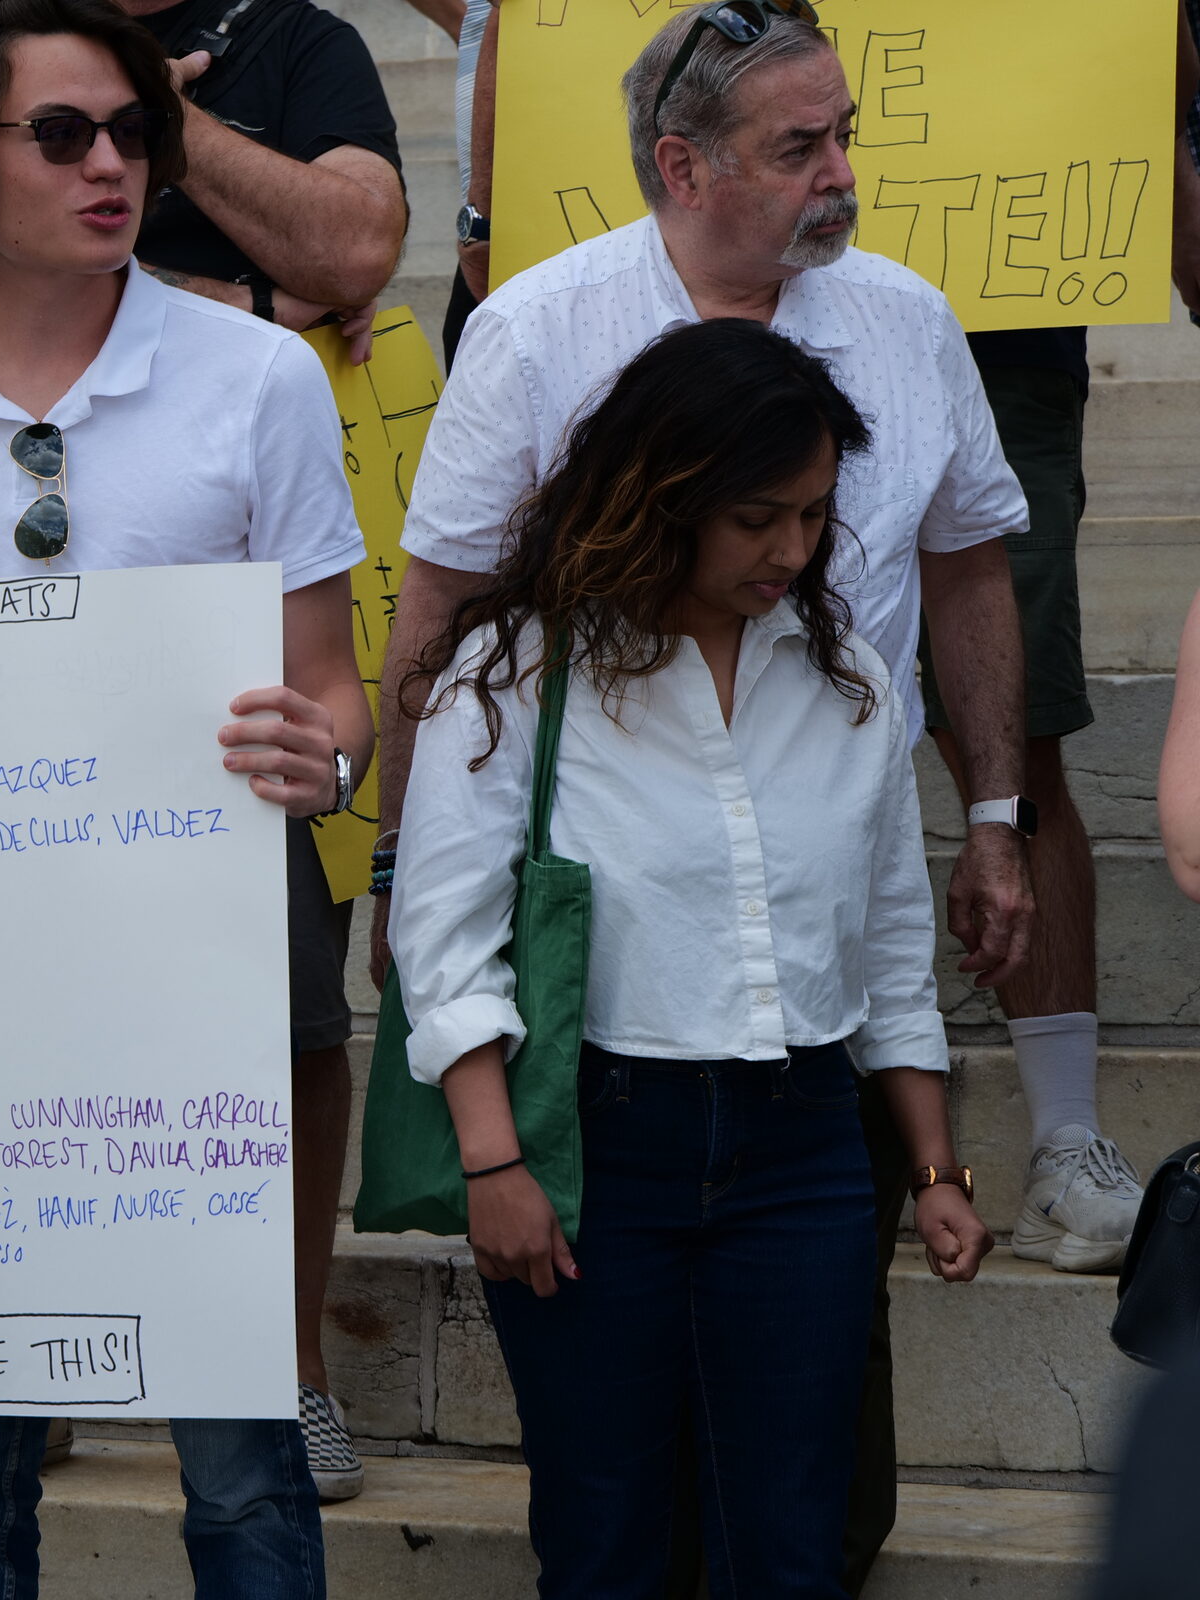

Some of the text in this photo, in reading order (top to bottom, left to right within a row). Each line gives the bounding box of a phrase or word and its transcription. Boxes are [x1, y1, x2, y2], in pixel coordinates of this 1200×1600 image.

[112, 808, 231, 845] VALDEZ
[10, 1095, 173, 1132] CUNNINGHAM,
[38, 1196, 107, 1229] HANIF,
[30, 1332, 132, 1382] THIS!
